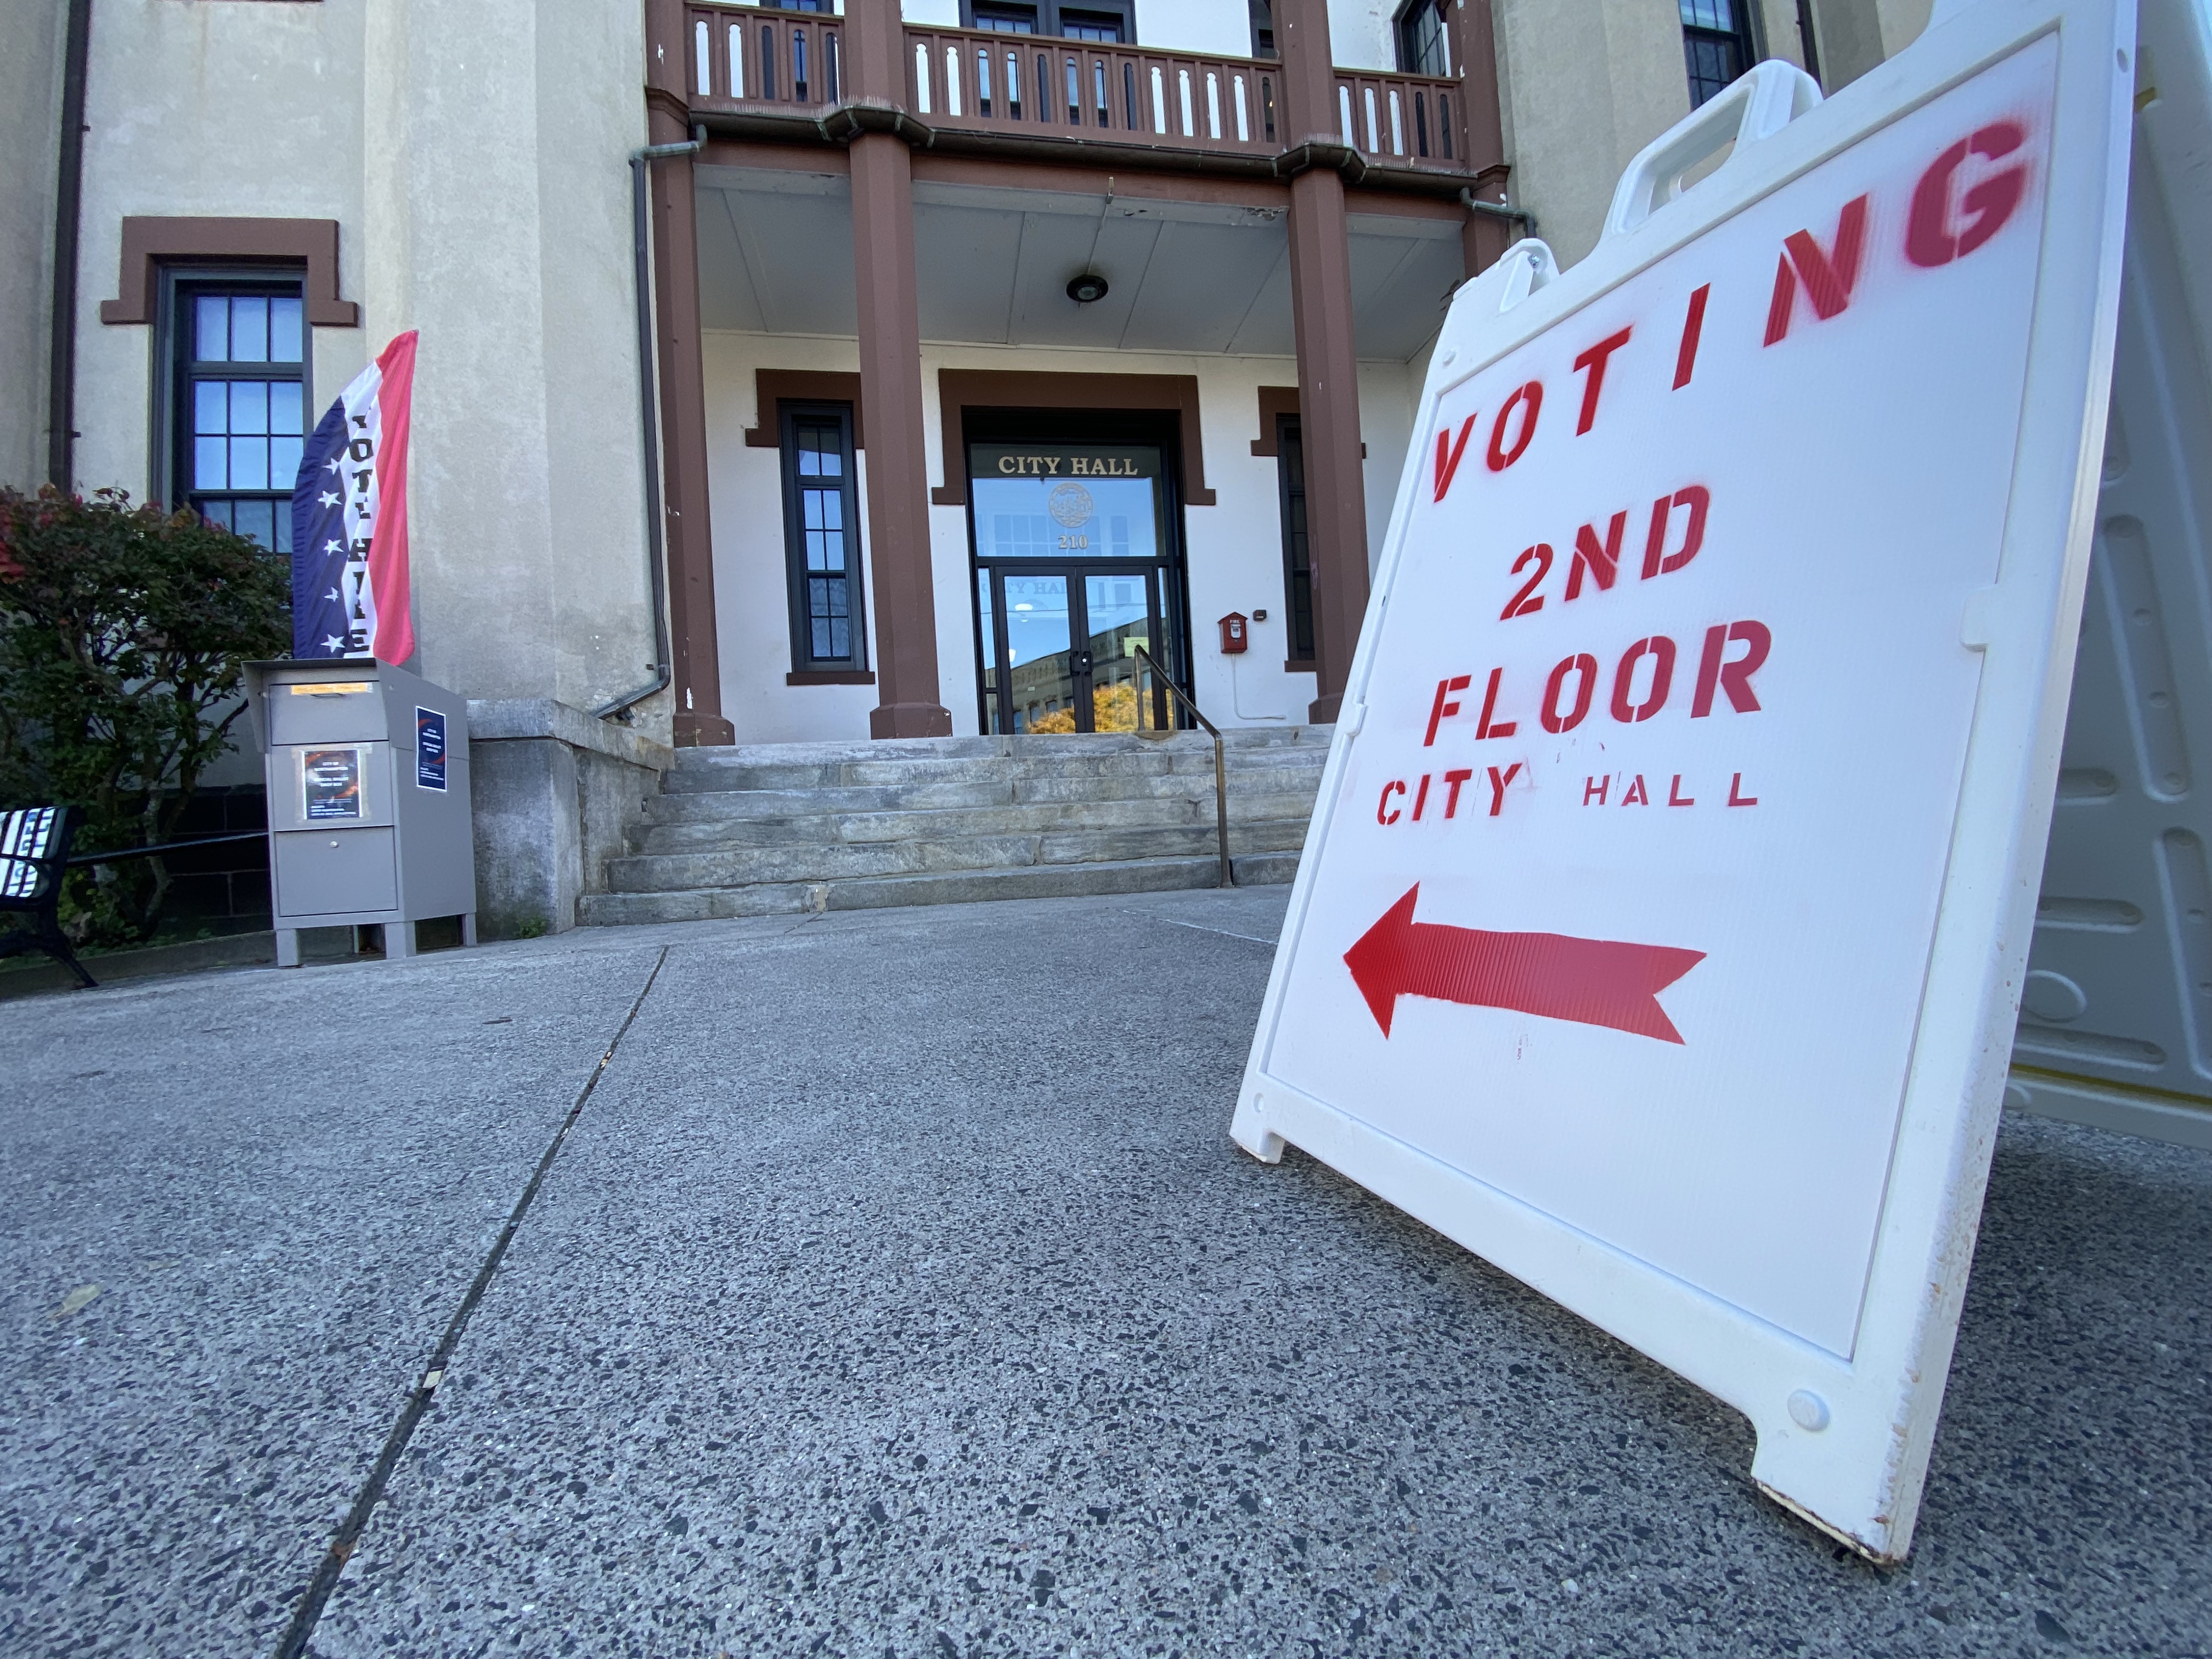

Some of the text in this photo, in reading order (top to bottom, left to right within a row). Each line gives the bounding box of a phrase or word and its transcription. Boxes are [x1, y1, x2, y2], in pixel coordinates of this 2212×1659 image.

[1434, 121, 2027, 503] VOTING
[998, 456, 1138, 476] CITY HALL
[1058, 534, 1088, 549] 210
[1499, 485, 1711, 620] 2ND
[1423, 620, 1771, 747] FLOOR
[1376, 763, 1758, 825] CITY HALL
